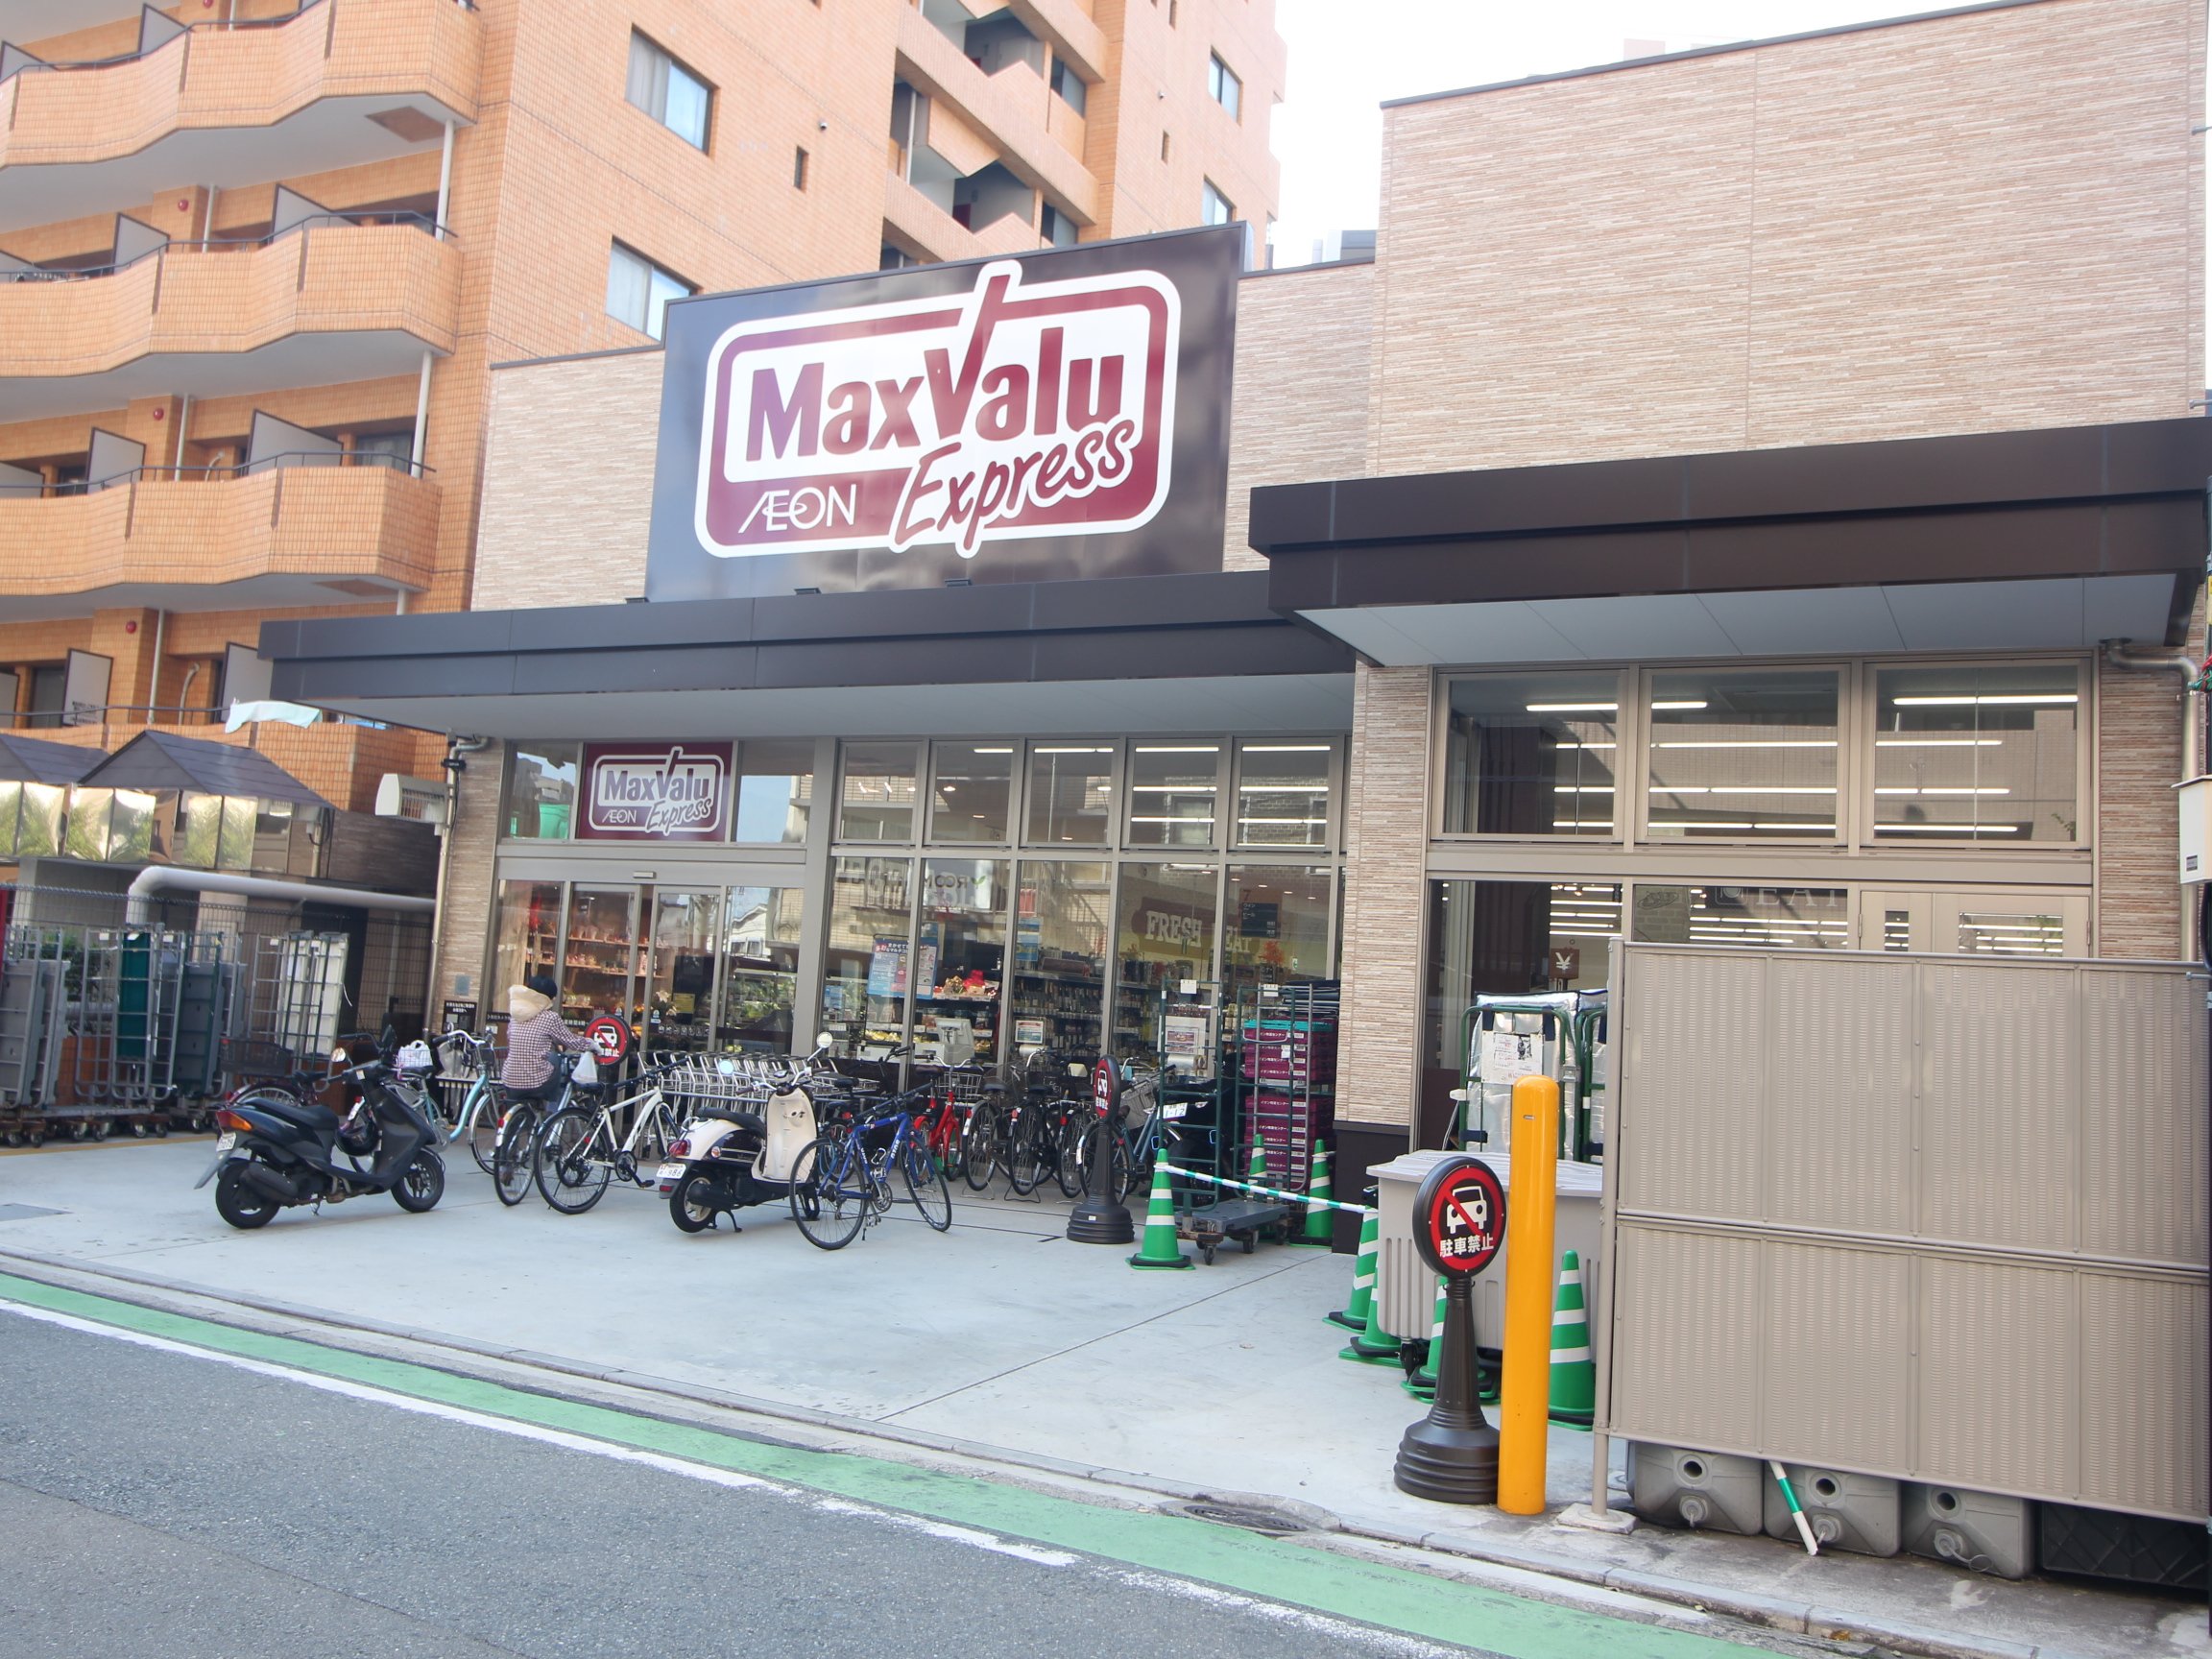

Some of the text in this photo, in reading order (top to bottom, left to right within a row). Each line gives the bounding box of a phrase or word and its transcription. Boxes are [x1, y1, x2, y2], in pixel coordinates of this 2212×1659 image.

[746, 276, 1124, 462] MaxValu
[894, 419, 1134, 551] Express
[604, 750, 709, 801] MaxValu
[646, 798, 711, 835] Express
[1143, 910, 1253, 953] FRESH EAT
[1440, 1233, 1494, 1258] 駐車禁止
